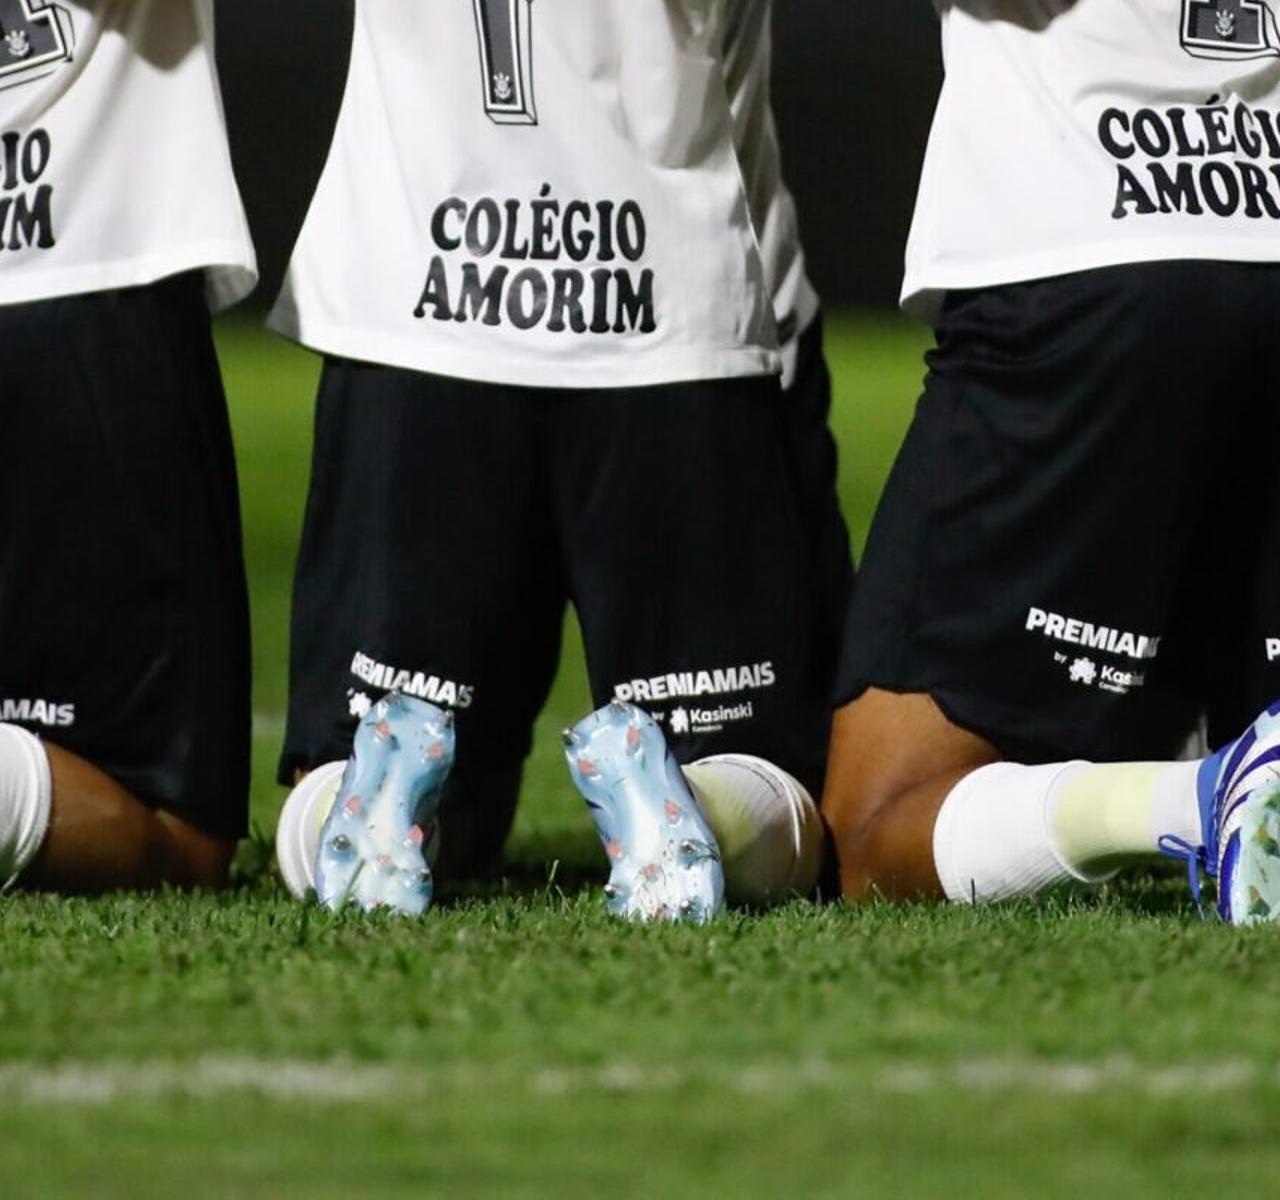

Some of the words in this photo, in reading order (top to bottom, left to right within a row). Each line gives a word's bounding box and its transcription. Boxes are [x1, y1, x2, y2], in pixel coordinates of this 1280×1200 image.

[431, 182, 646, 262] COLÉGIO
[413, 254, 657, 334] AMORIM
[614, 661, 776, 702] PREMIAMAIS
[690, 701, 753, 724] Kasinski
